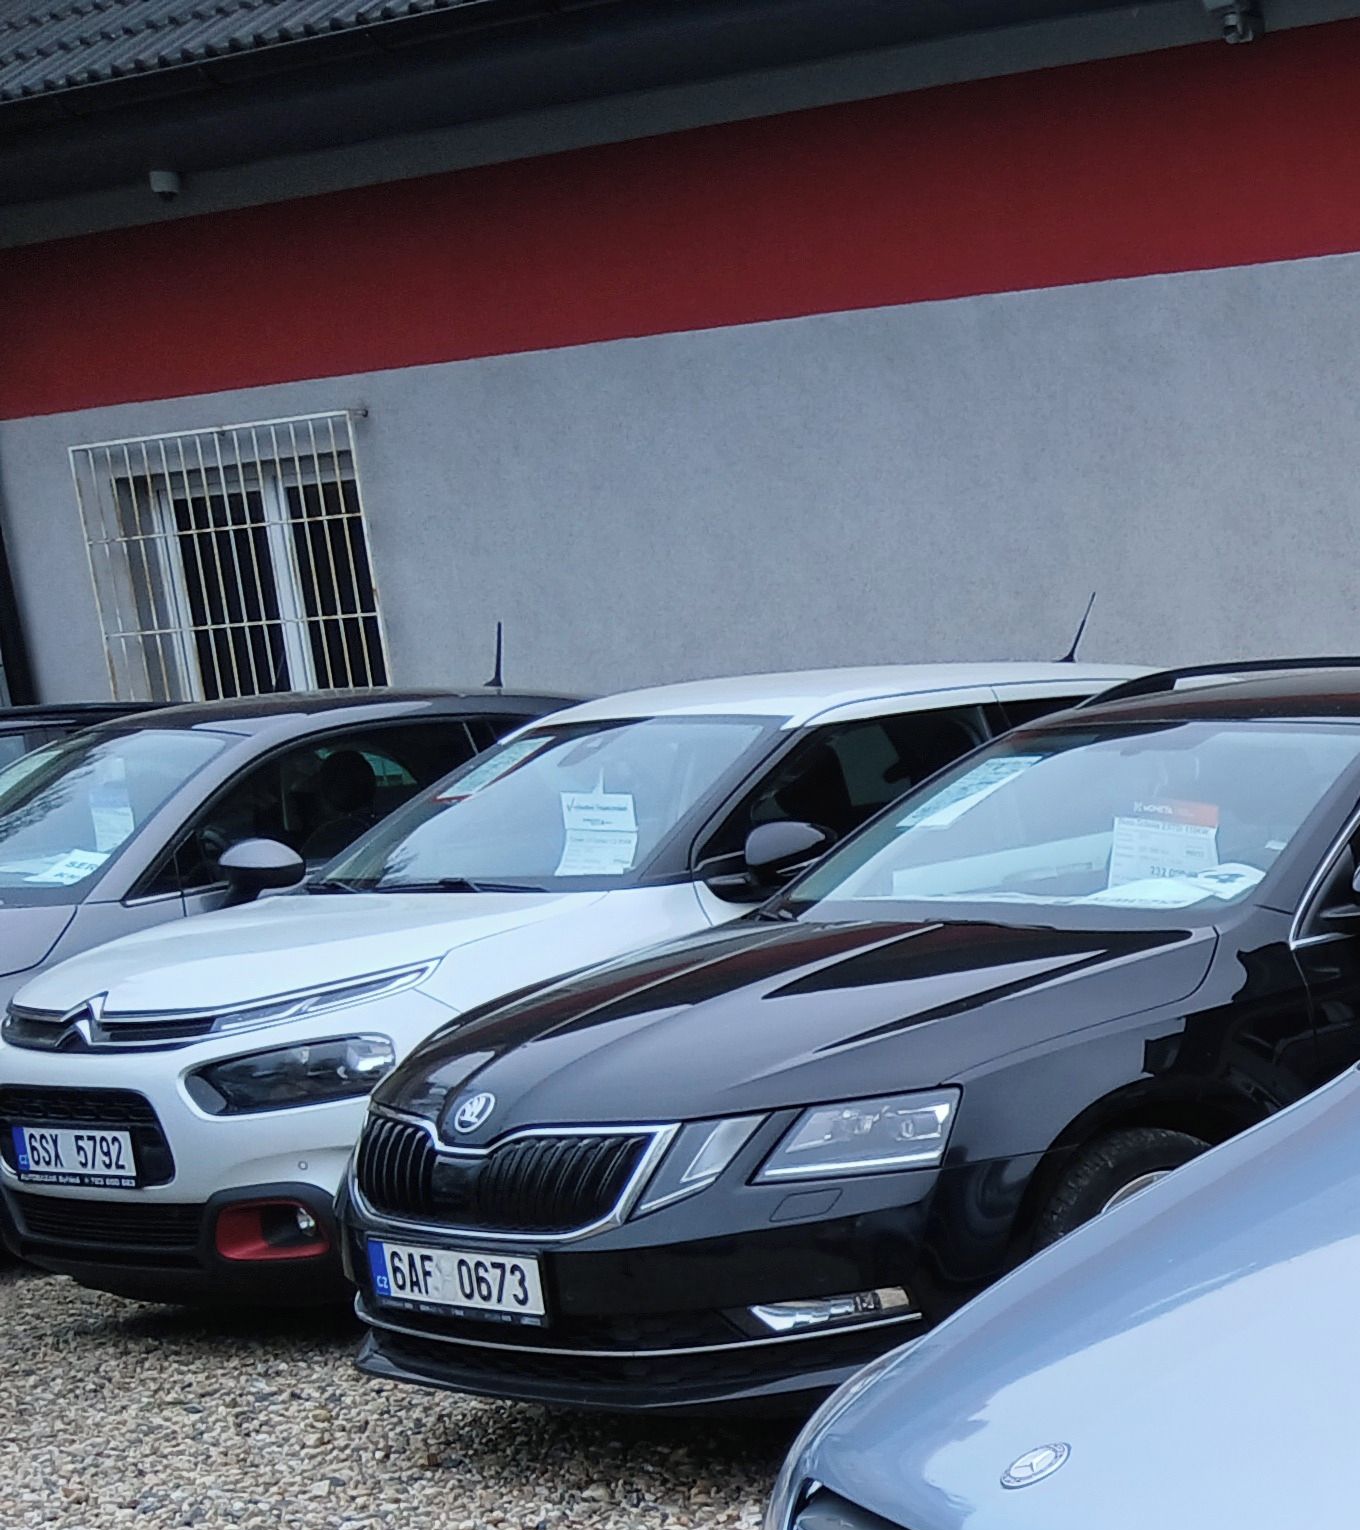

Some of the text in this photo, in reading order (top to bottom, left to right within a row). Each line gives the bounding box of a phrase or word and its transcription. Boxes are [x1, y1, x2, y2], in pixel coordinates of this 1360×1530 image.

[28, 1132, 65, 1168] 6SX
[73, 1134, 126, 1170] 5792
[376, 1251, 529, 1306] CZ 6AF 0673
